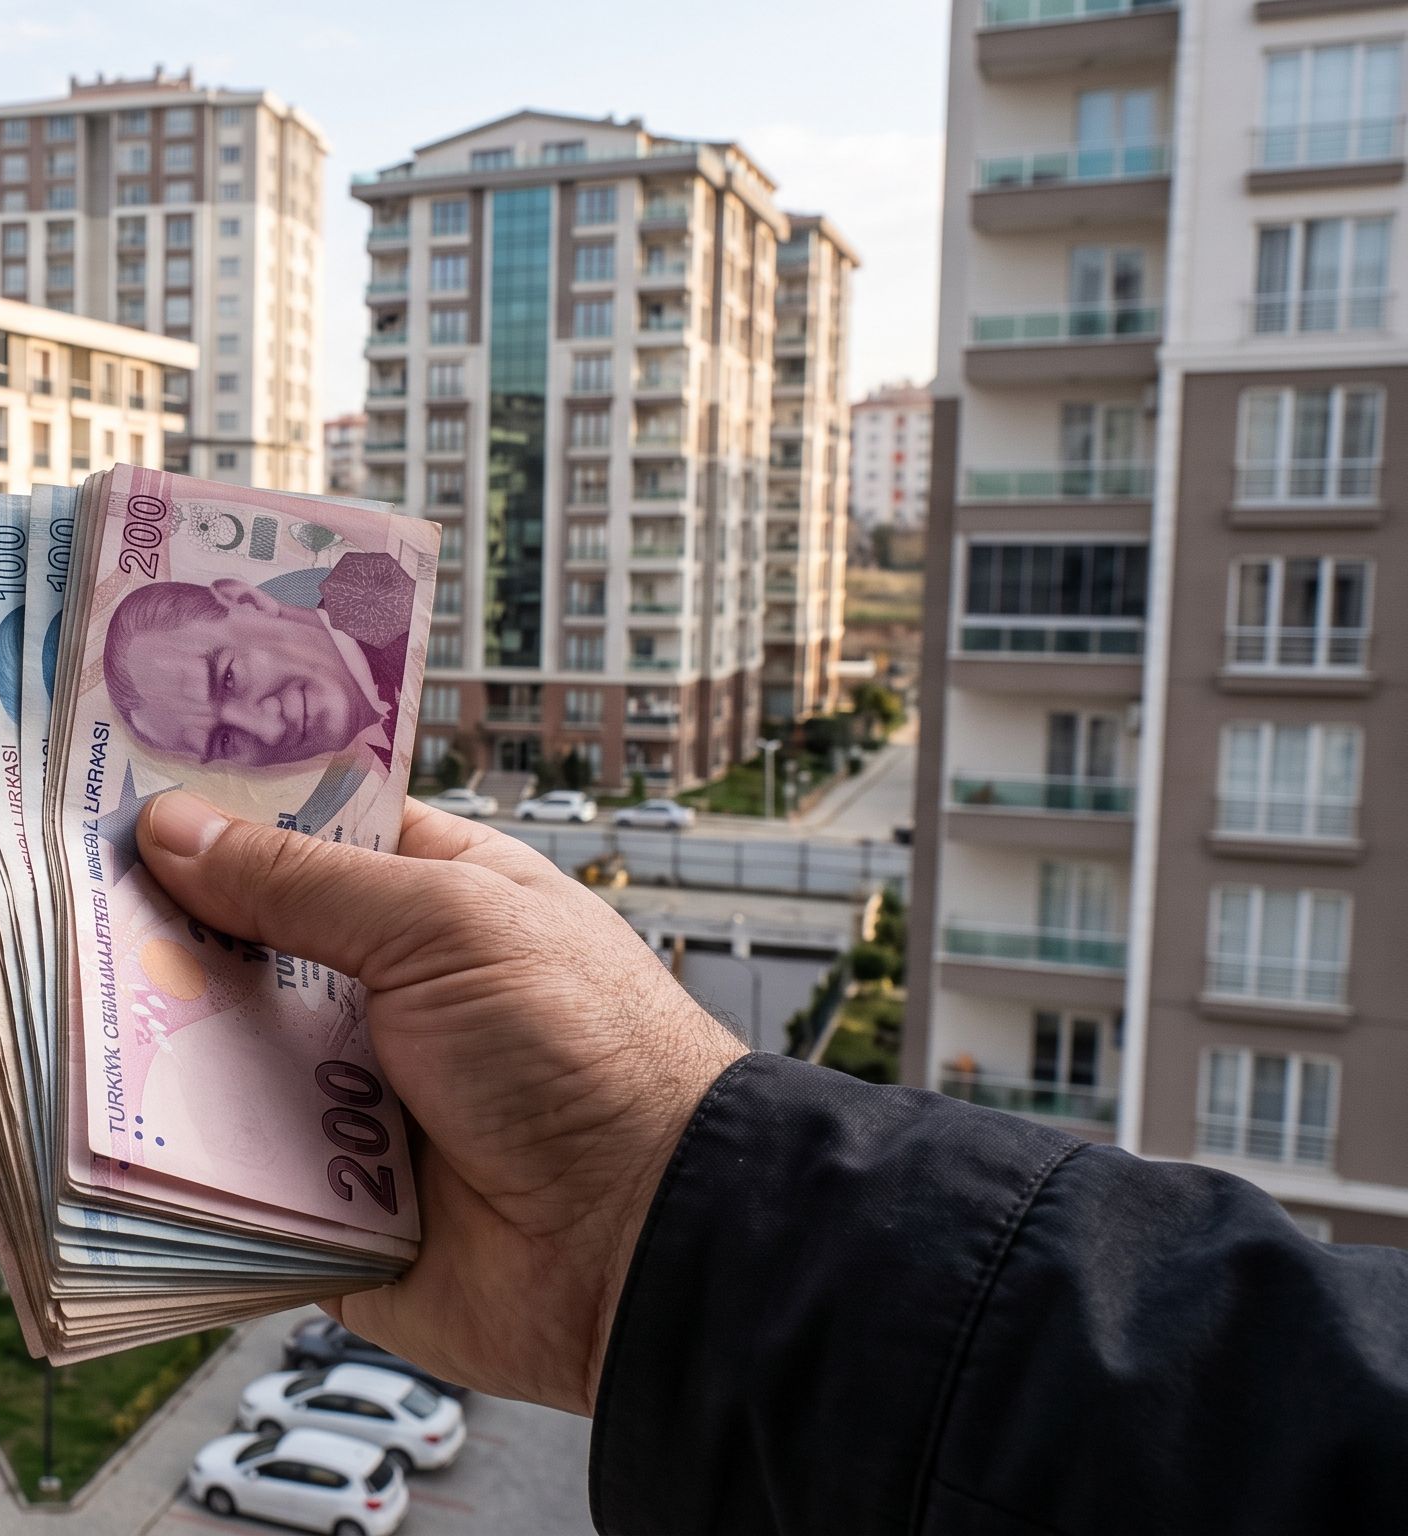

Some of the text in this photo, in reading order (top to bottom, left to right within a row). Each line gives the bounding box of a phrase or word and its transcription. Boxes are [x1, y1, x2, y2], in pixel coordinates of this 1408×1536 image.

[46, 518, 74, 592] 100
[119, 493, 167, 579] 200
[315, 1059, 396, 1216] 200
